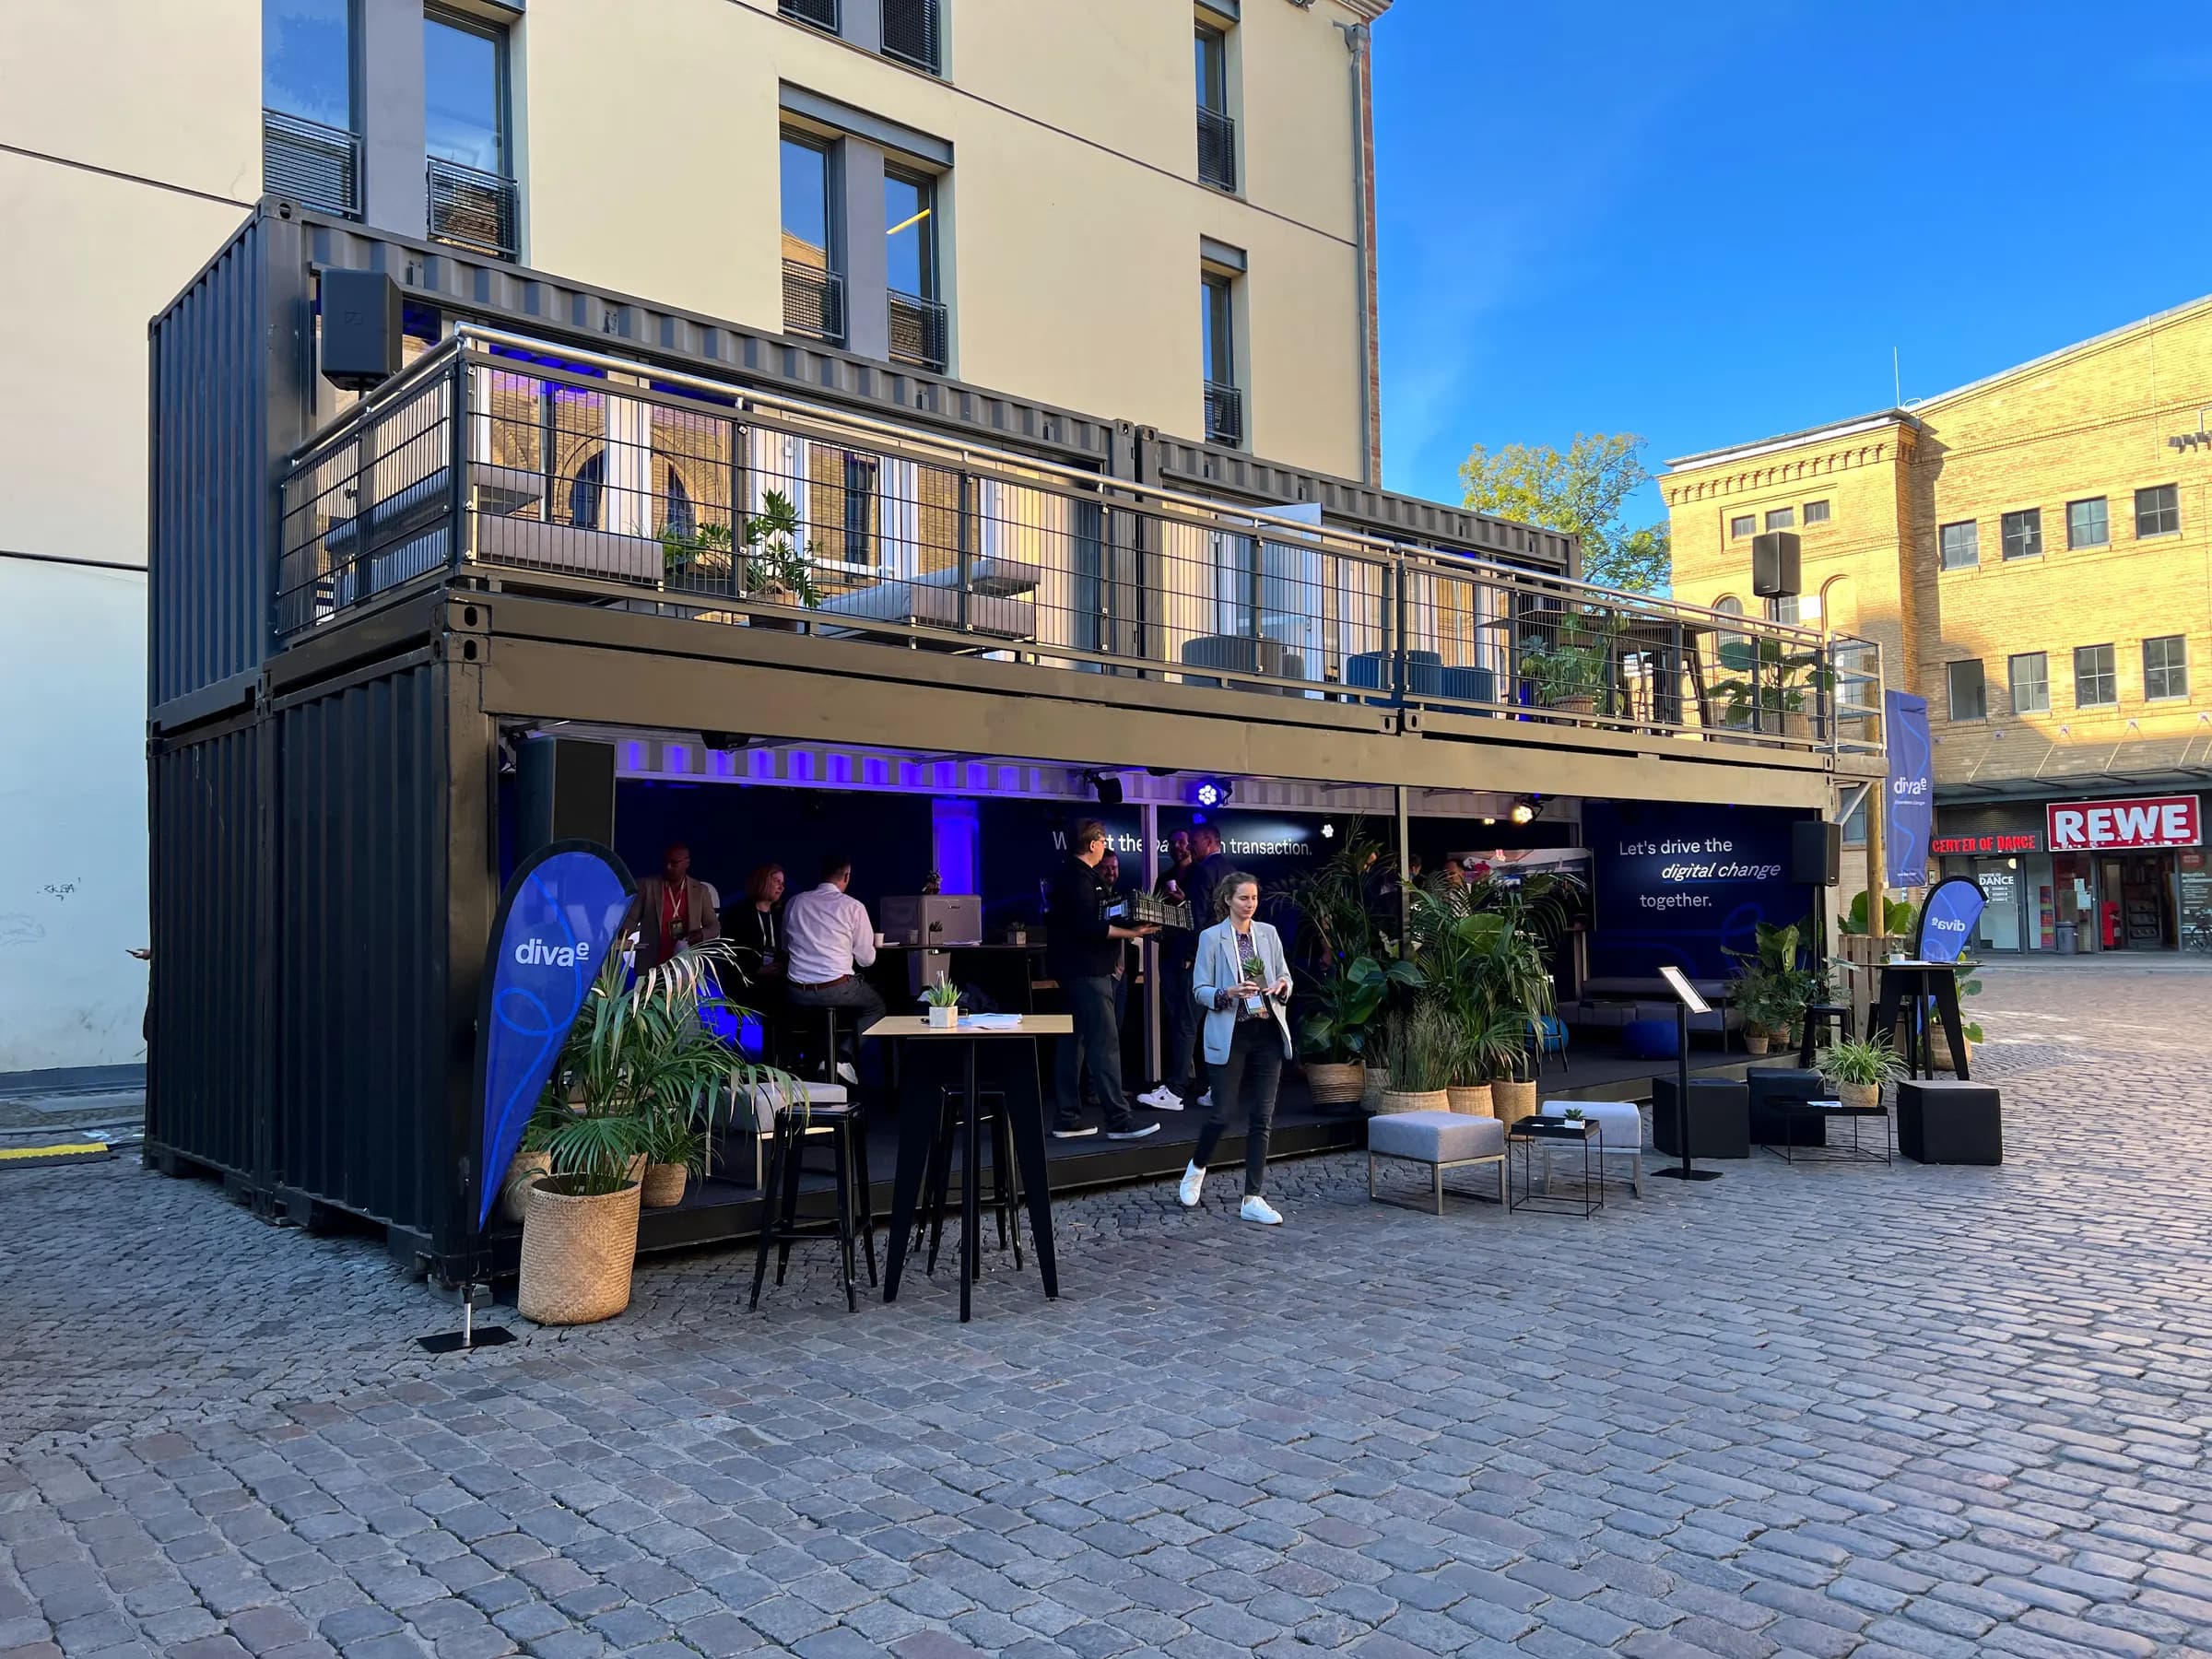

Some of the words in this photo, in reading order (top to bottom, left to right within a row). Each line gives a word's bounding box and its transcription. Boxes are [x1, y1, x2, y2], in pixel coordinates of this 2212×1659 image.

[2054, 804, 2191, 842] REWE
[1118, 832, 1142, 853] the
[1230, 838, 1312, 856] transaction.
[1619, 840, 1656, 855] Let's
[1661, 839, 1700, 853] drive
[1705, 838, 1733, 853] the
[1932, 838, 1976, 853] CENTER
[1979, 837, 1994, 852] OF
[1996, 835, 2035, 851] DANCE
[1662, 863, 1717, 881] digital
[1718, 862, 1781, 879] change
[1979, 876, 2014, 886] DANCE
[1640, 892, 1712, 911] together.
